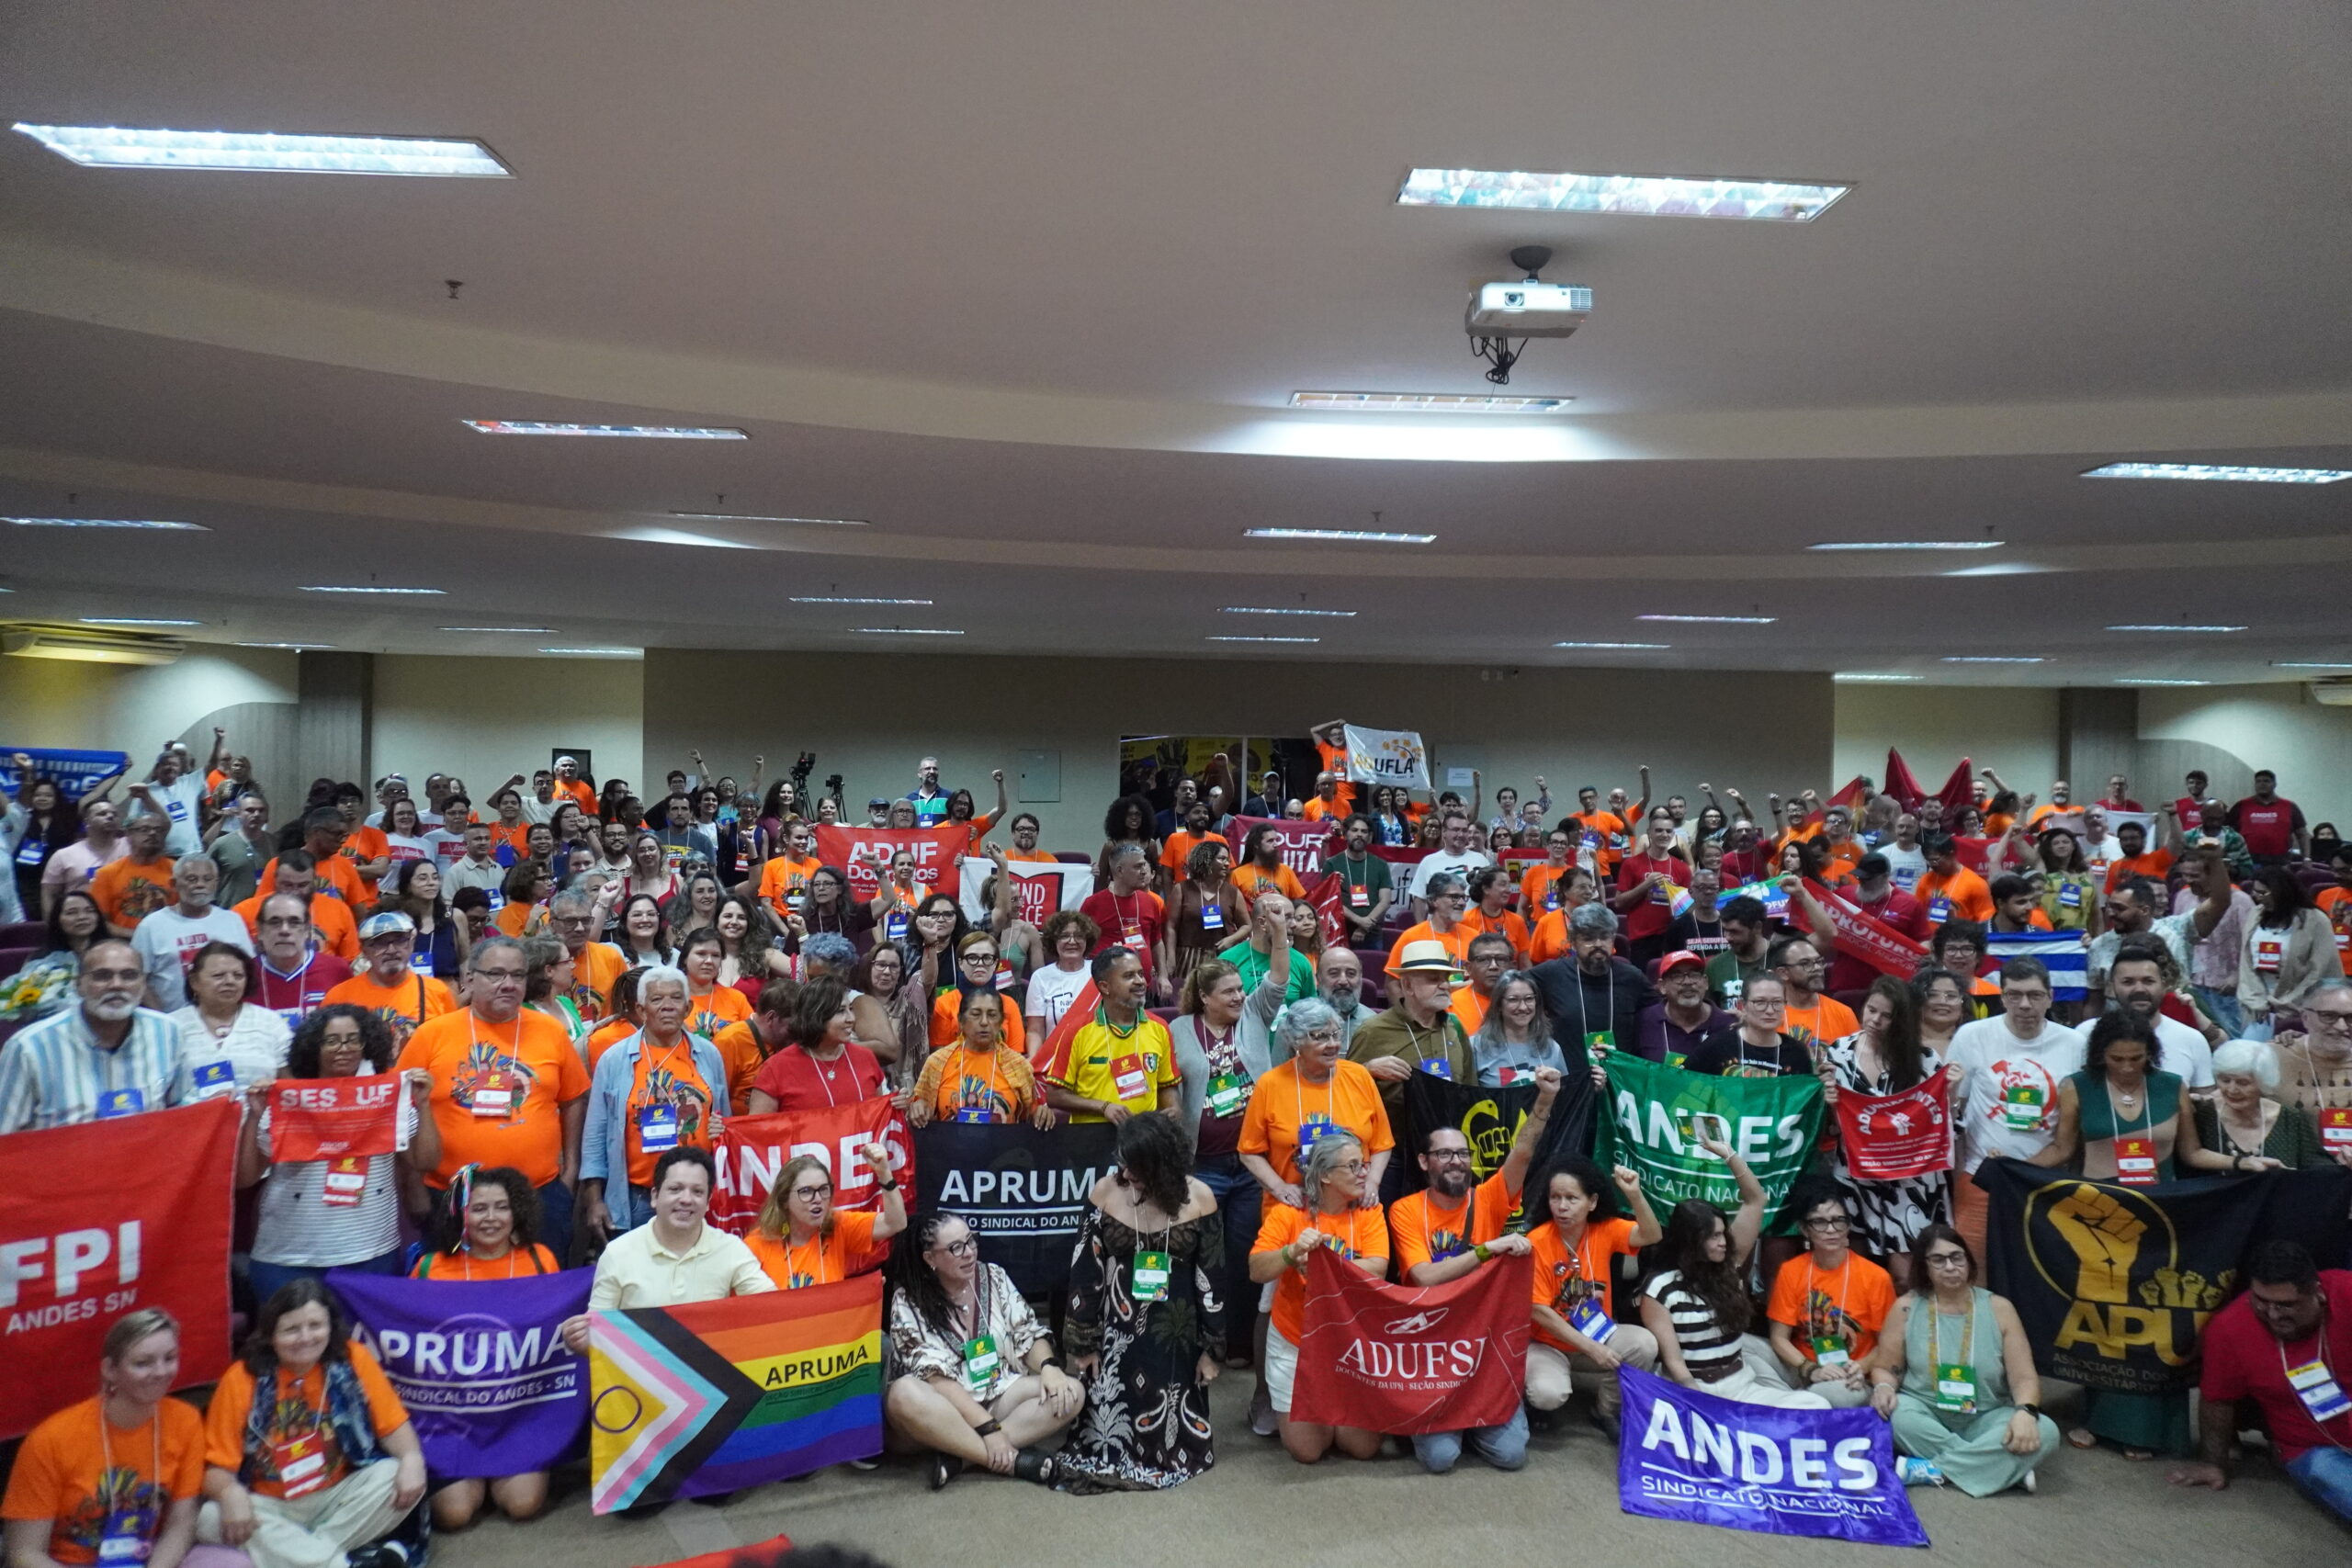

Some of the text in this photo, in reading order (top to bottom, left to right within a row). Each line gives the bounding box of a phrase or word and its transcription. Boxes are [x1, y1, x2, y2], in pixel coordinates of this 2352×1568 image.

[279, 1088, 338, 1109] SES
[1616, 1089, 1804, 1163] ANDES
[1613, 1150, 1701, 1200] SIDICATO
[980, 1215, 1037, 1228] SINDICAL
[1040, 1216, 1058, 1227] DO
[5, 1288, 138, 1337] ANDES SN
[764, 1344, 869, 1387] APRUMA
[1338, 1337, 1487, 1379] ADUFSJ
[466, 1392, 490, 1404] DO
[493, 1381, 543, 1402] ANDES
[554, 1373, 576, 1390] SN
[1641, 1398, 1879, 1491] ANDES
[1641, 1475, 1893, 1516] SINDICATO NACIONAL
